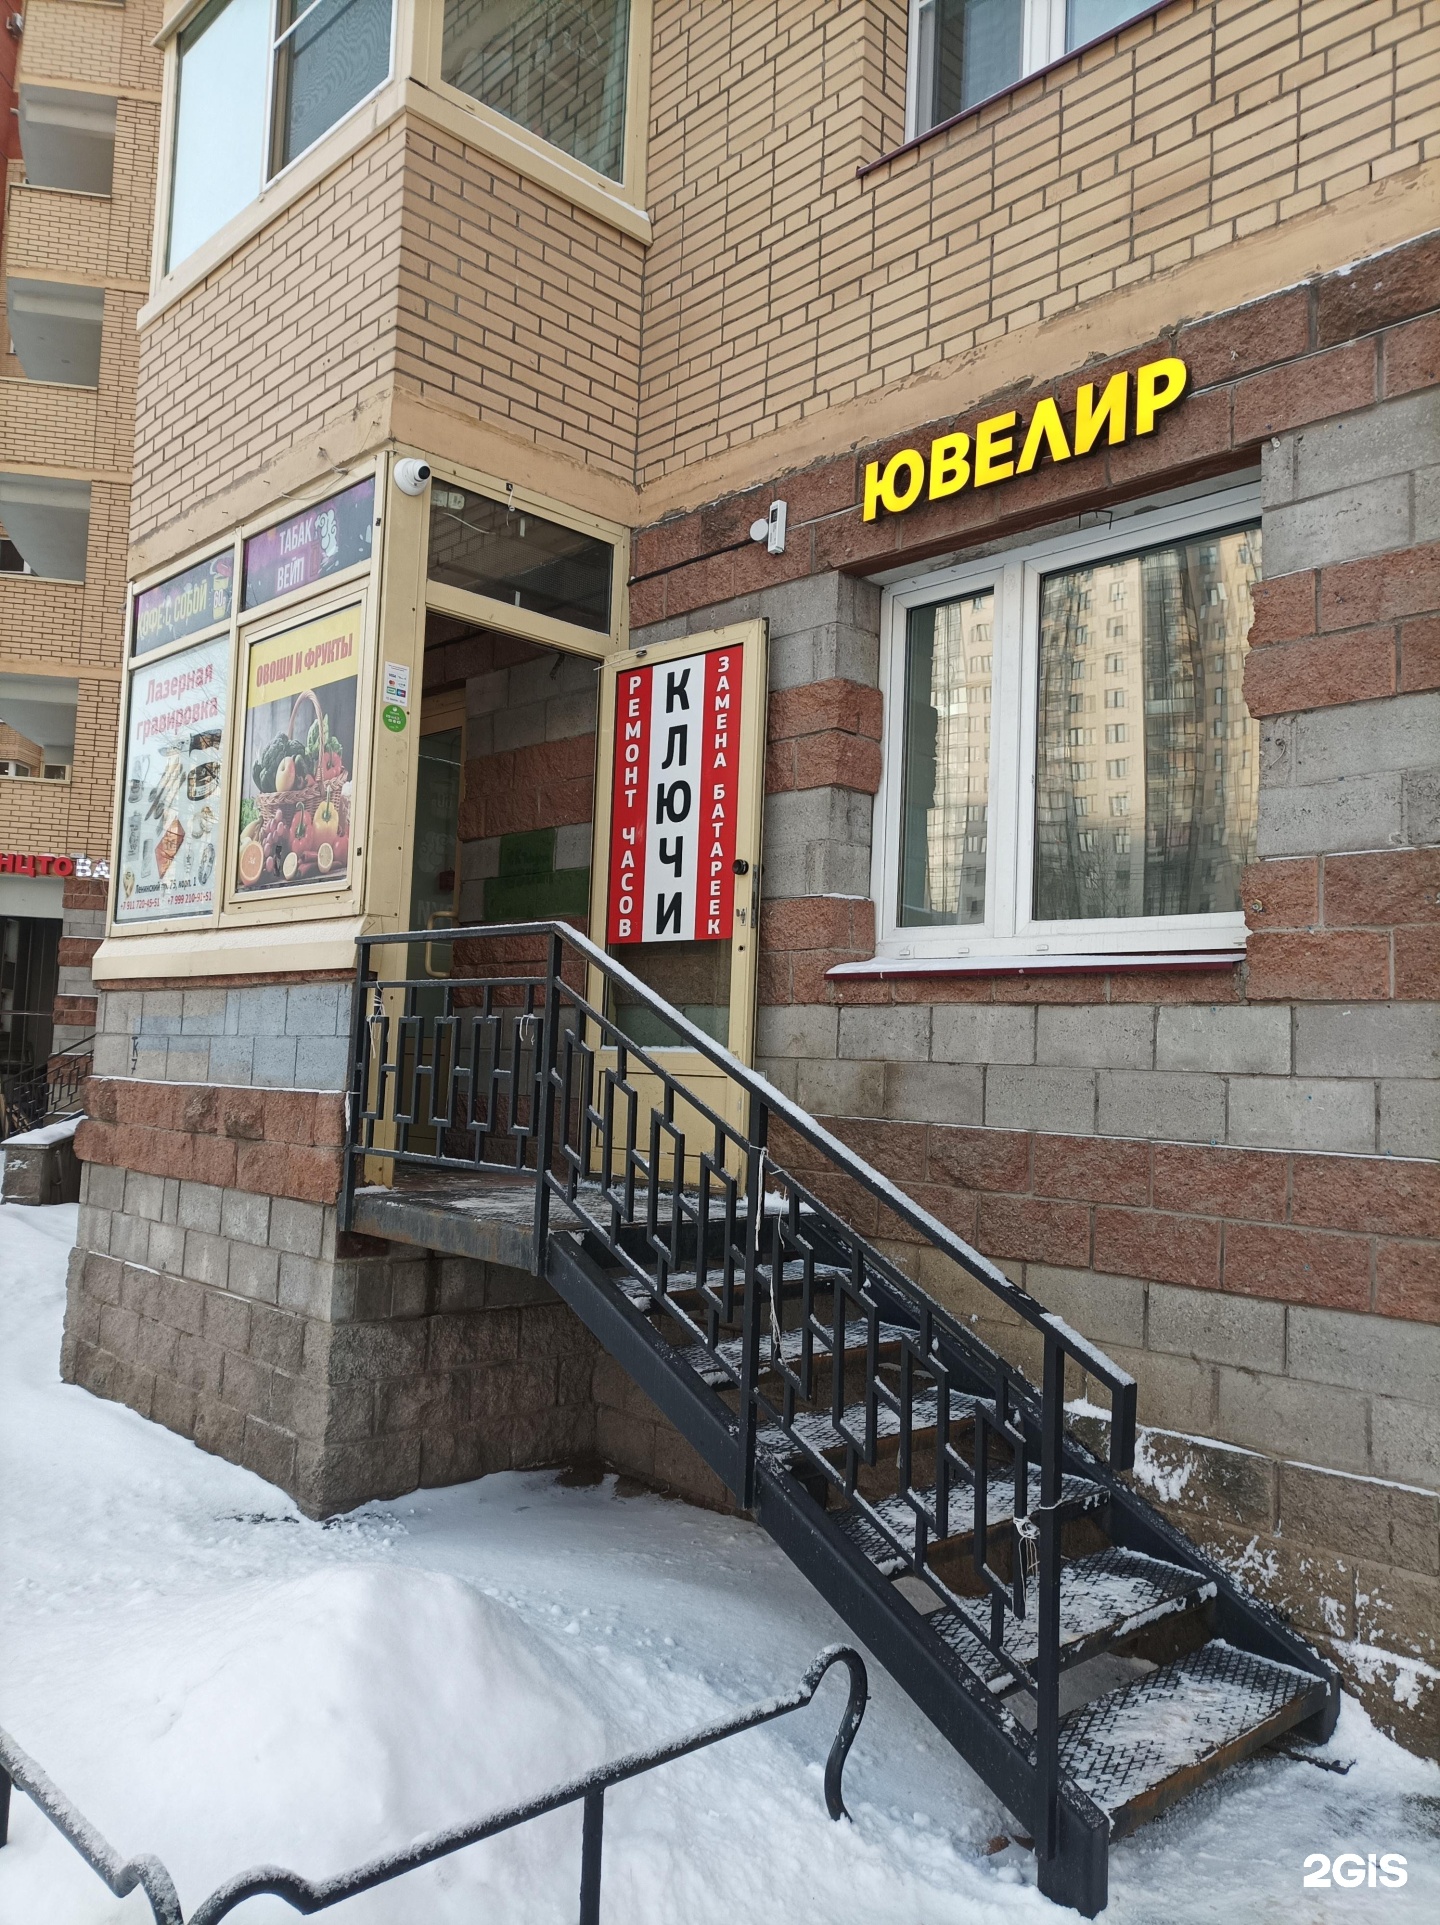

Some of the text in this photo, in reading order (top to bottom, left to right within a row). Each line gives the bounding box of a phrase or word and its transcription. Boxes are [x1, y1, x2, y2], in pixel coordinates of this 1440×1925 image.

[863, 357, 1188, 522] ЮВЕЛИР
[280, 516, 313, 555] ТАБАК
[277, 555, 305, 592] ВЕЙП
[174, 579, 208, 622] СОБОЙ
[256, 633, 353, 687] ОВОЩИ И ФРУКТЫ
[146, 664, 213, 705] Лазерная
[137, 697, 218, 745] гравировка
[618, 675, 642, 938] РЕМОНТ ЧАСОВ
[656, 668, 691, 935] КЛЮЧИ
[707, 656, 730, 936] ЗАМЕНА БАТАРЕЕК
[174, 894, 184, 905] 999
